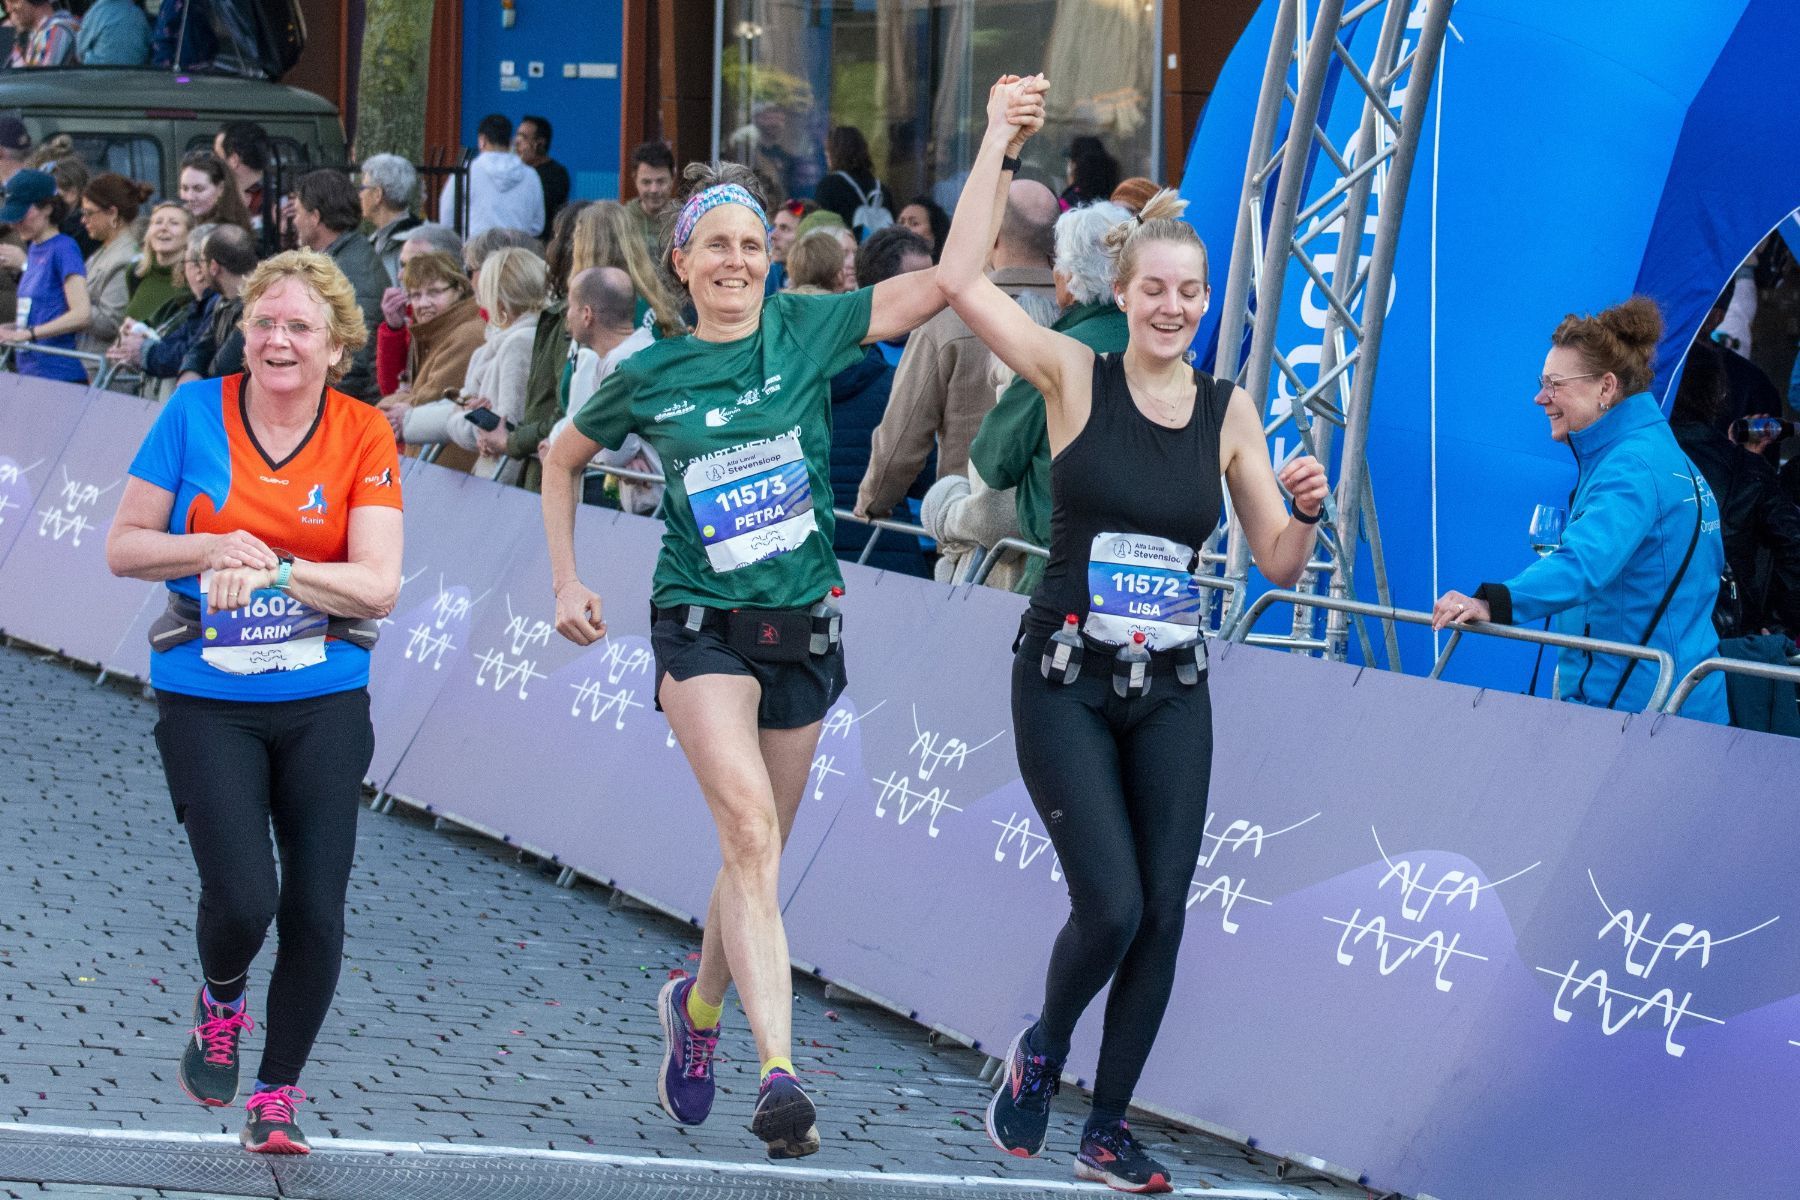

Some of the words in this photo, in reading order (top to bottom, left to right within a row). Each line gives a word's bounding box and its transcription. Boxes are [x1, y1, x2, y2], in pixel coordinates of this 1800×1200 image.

[728, 454, 782, 475] Stevensloop
[715, 474, 787, 512] 11573
[301, 516, 324, 525] Karin
[735, 504, 785, 531] PETRA
[1111, 572, 1180, 598] 11572
[1128, 601, 1161, 616] LISA
[240, 625, 292, 641] KARIN
[1330, 908, 1472, 993] LAVAL
[1544, 959, 1706, 1058] LAVAL
